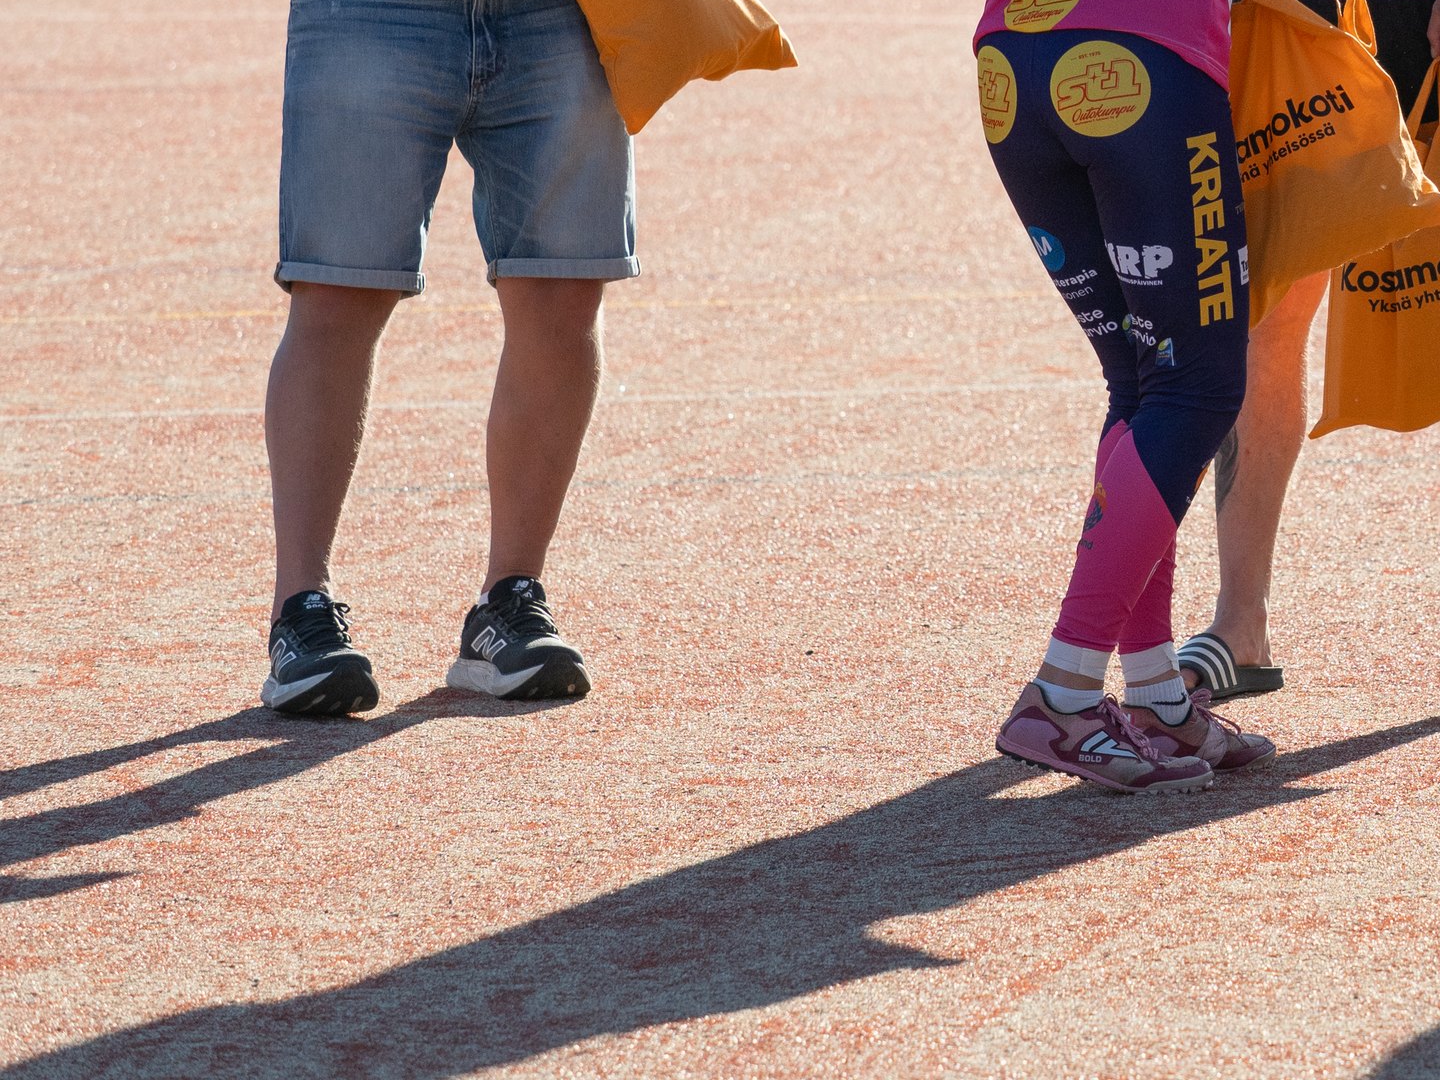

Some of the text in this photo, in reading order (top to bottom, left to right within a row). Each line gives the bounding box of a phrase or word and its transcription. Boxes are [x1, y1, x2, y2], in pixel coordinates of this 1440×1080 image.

[1072, 104, 1136, 123] Outokumpu
[1236, 84, 1355, 164] amokoti
[1240, 163, 1260, 183] nä
[1186, 132, 1234, 327] KREATE
[1054, 269, 1098, 288] terapia
[1076, 309, 1104, 323] ste
[1131, 315, 1153, 330] ste
[1078, 754, 1102, 763] BOLD
